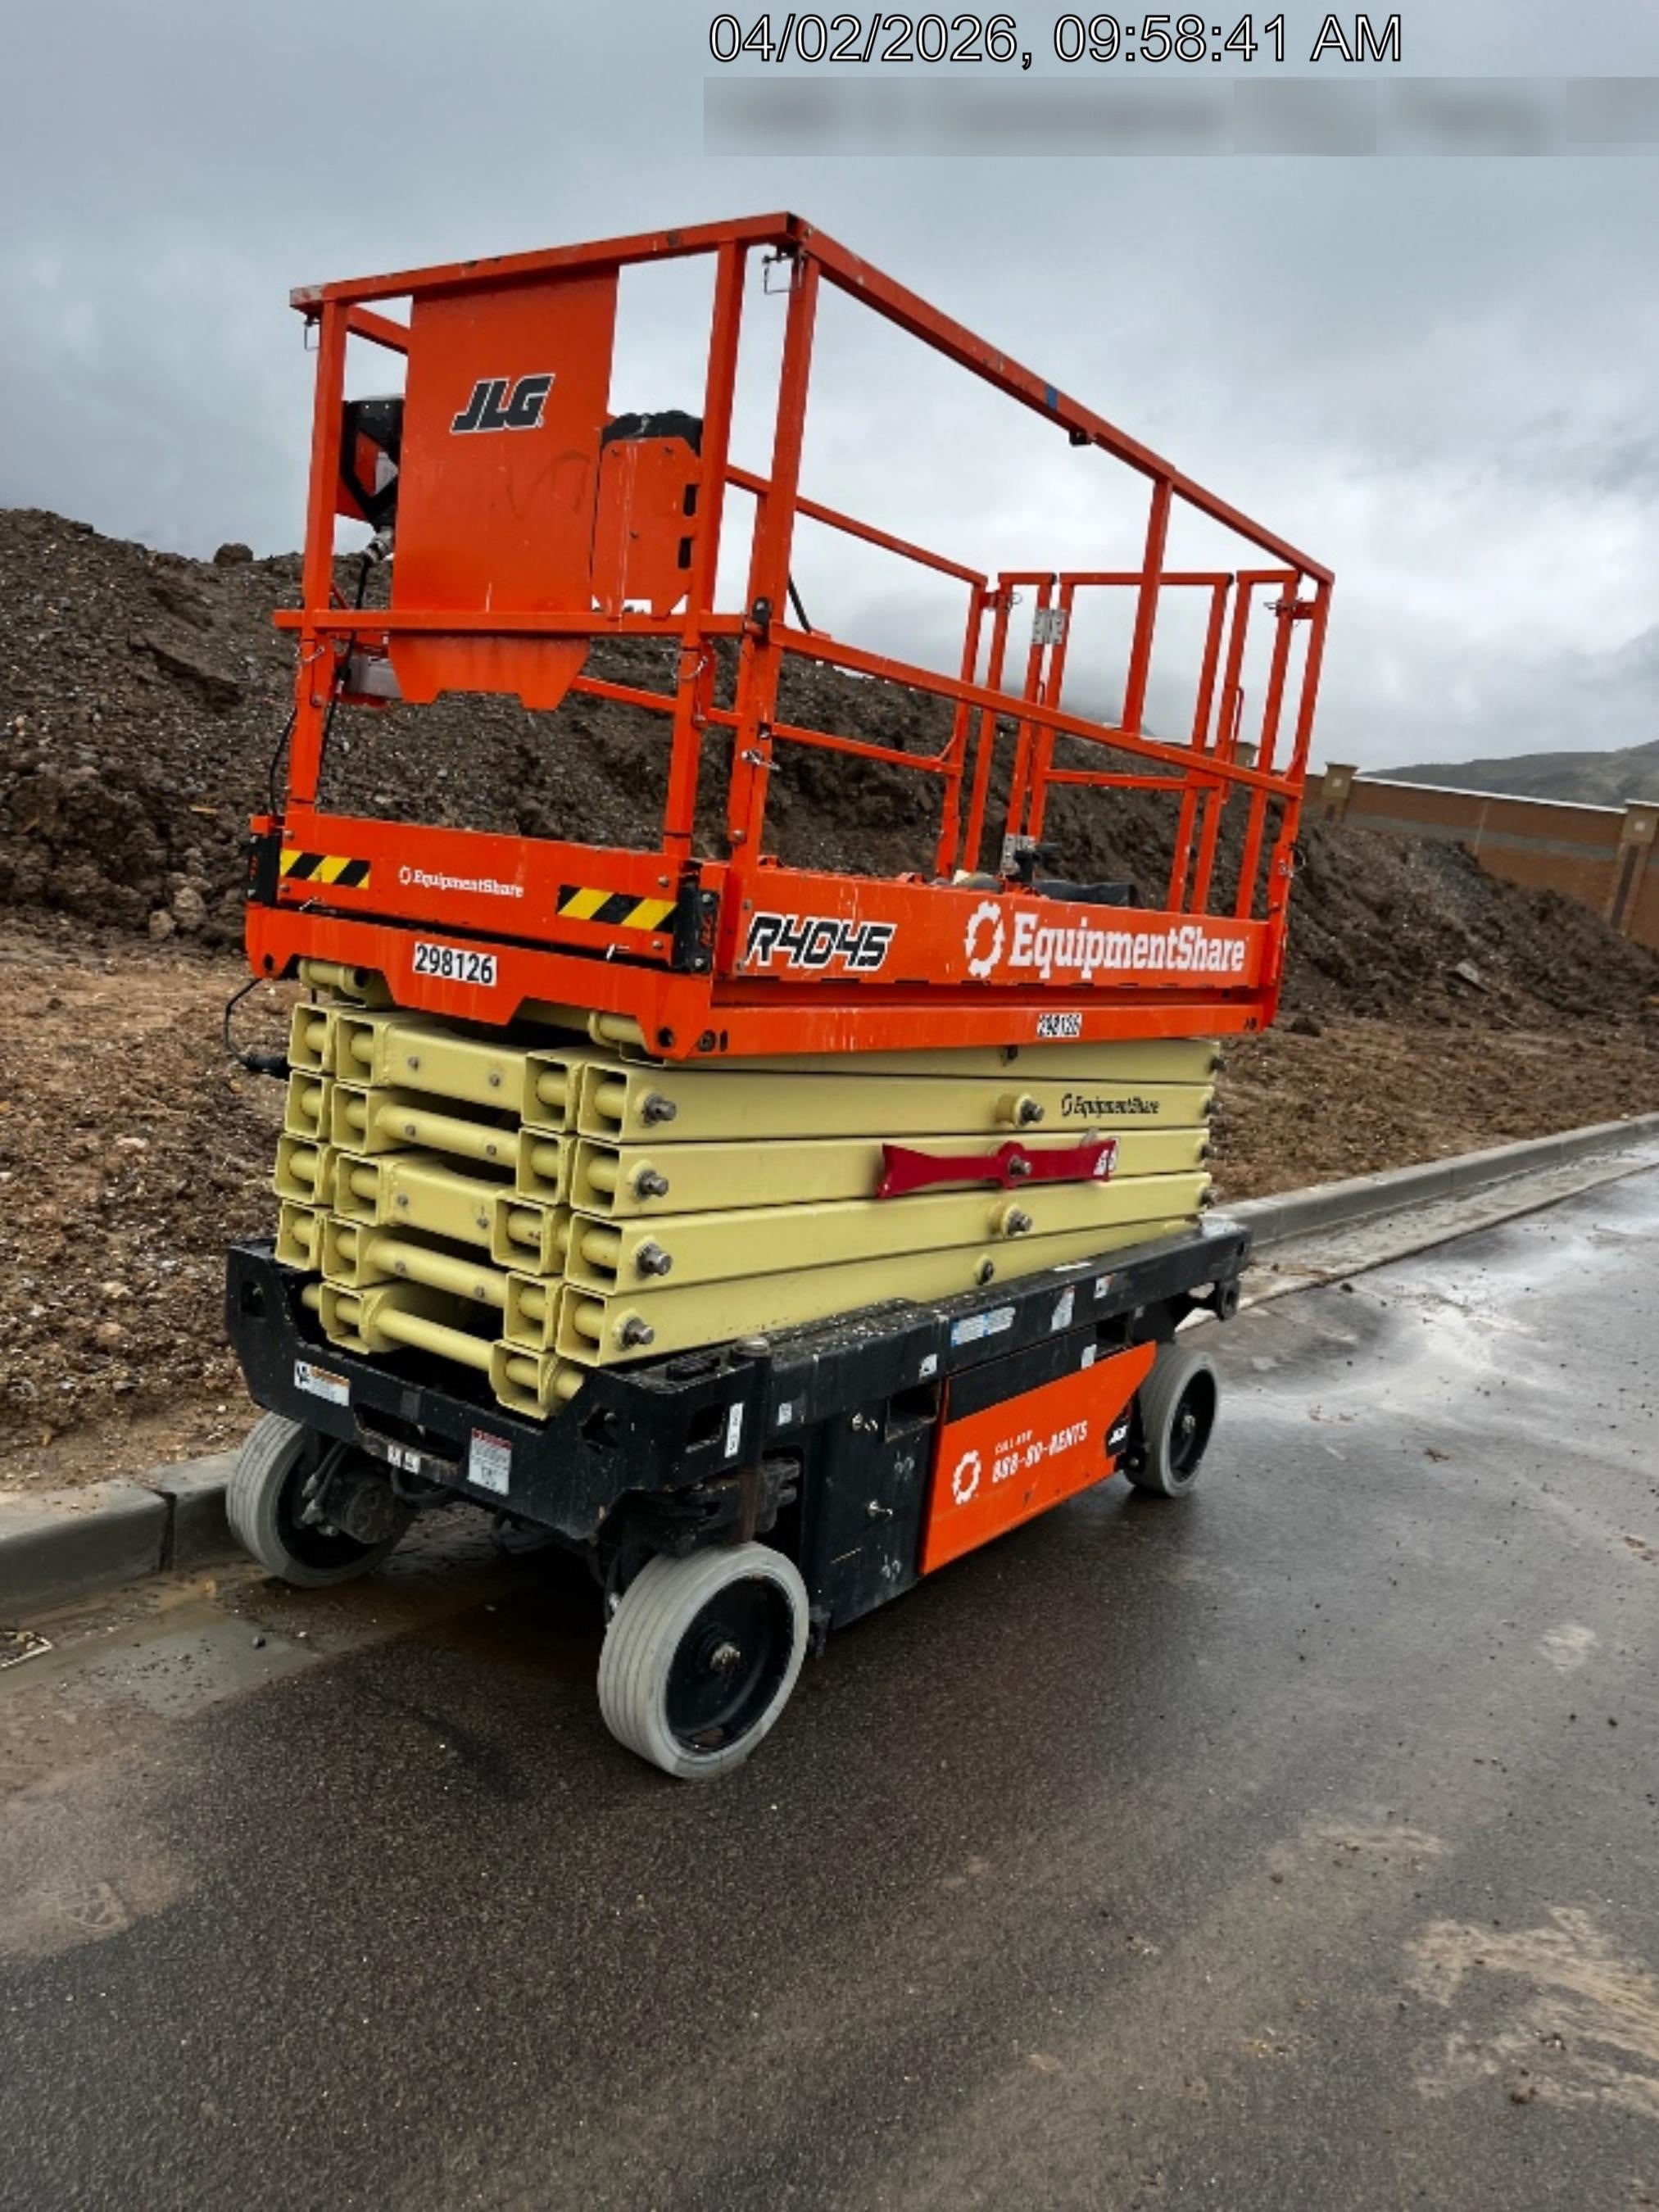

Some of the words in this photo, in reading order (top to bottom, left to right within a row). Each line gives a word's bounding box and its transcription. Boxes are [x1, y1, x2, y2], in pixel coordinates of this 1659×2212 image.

[450, 373, 555, 434] JLG
[413, 870, 524, 898] EquipmentShare
[415, 945, 493, 984] 298126
[1009, 912, 1245, 979] EquipmentShare
